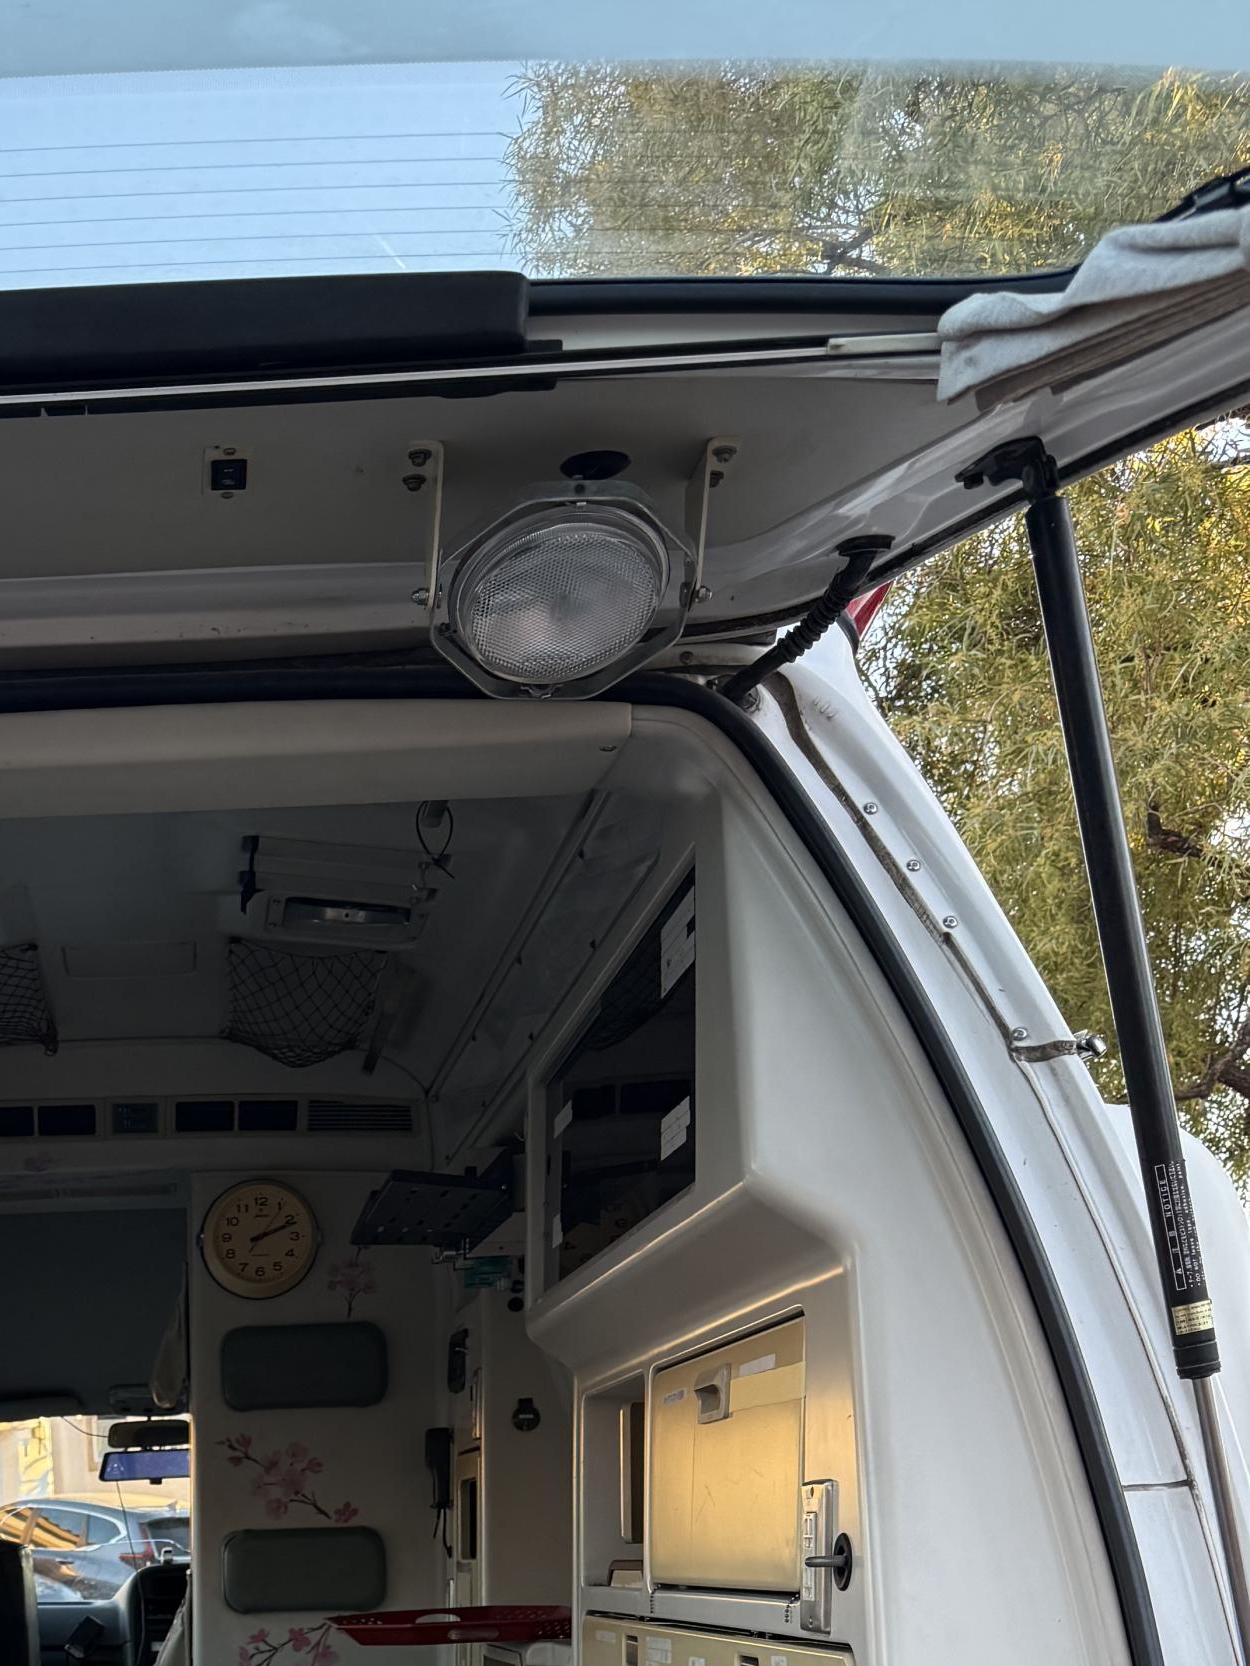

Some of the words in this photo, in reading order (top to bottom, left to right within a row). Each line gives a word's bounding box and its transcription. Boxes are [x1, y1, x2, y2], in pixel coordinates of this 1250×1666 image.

[255, 1197, 269, 1206] 12
[1159, 1179, 1172, 1217] NOTICE
[236, 1204, 248, 1213] 11
[226, 1217, 239, 1226] 10
[285, 1215, 296, 1224] 2
[222, 1233, 231, 1242] 9
[290, 1232, 300, 1240] 3
[226, 1249, 235, 1259] 8
[239, 1263, 248, 1272] 7
[273, 1262, 283, 1271] 5
[255, 1267, 265, 1276] 6
